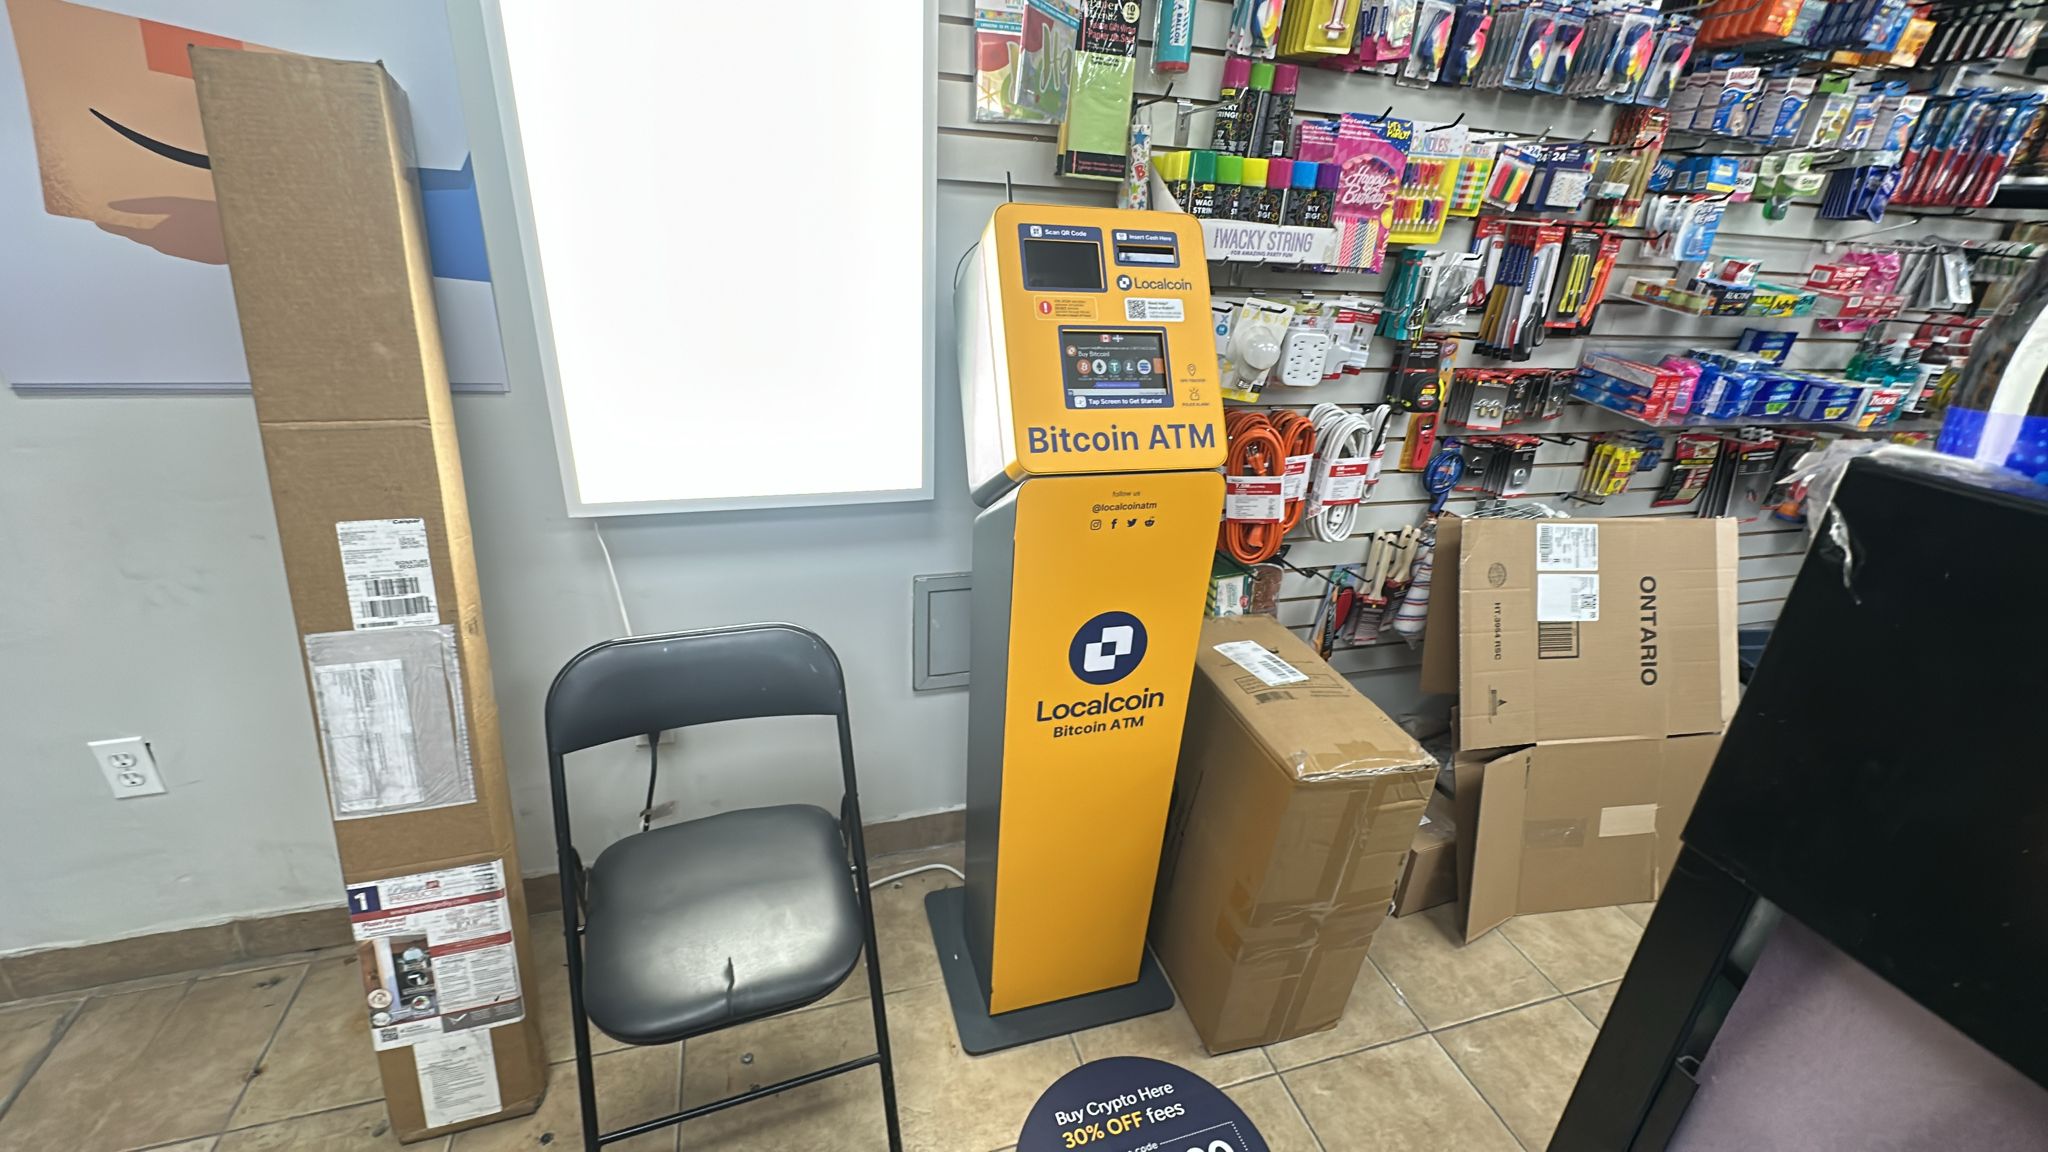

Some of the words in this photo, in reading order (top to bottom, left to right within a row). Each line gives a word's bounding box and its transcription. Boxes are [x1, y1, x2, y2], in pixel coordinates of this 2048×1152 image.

[1174, 13, 1185, 44] BALLON
[1552, 152, 1566, 161] 24
[1345, 165, 1392, 192] Happy
[1220, 228, 1264, 251] WACKY
[1267, 231, 1313, 252] STRING
[1134, 277, 1192, 291] Localcoin
[1028, 424, 1138, 453] Bitcoin
[1149, 423, 1216, 450] ATM
[1092, 502, 1157, 513] @localcoinatm
[1639, 575, 1658, 686] ONTARIO
[1036, 687, 1165, 722] Localcoin
[1053, 722, 1107, 738] Bitcoin
[1109, 716, 1144, 731] ATM
[353, 892, 369, 911] 1
[1055, 1107, 1084, 1126] Buy
[1086, 1095, 1137, 1117] Crypto
[1137, 1082, 1174, 1102] Here
[1061, 1124, 1105, 1149] 30%
[1106, 1111, 1143, 1136] OFF
[1145, 1101, 1185, 1124] fees
